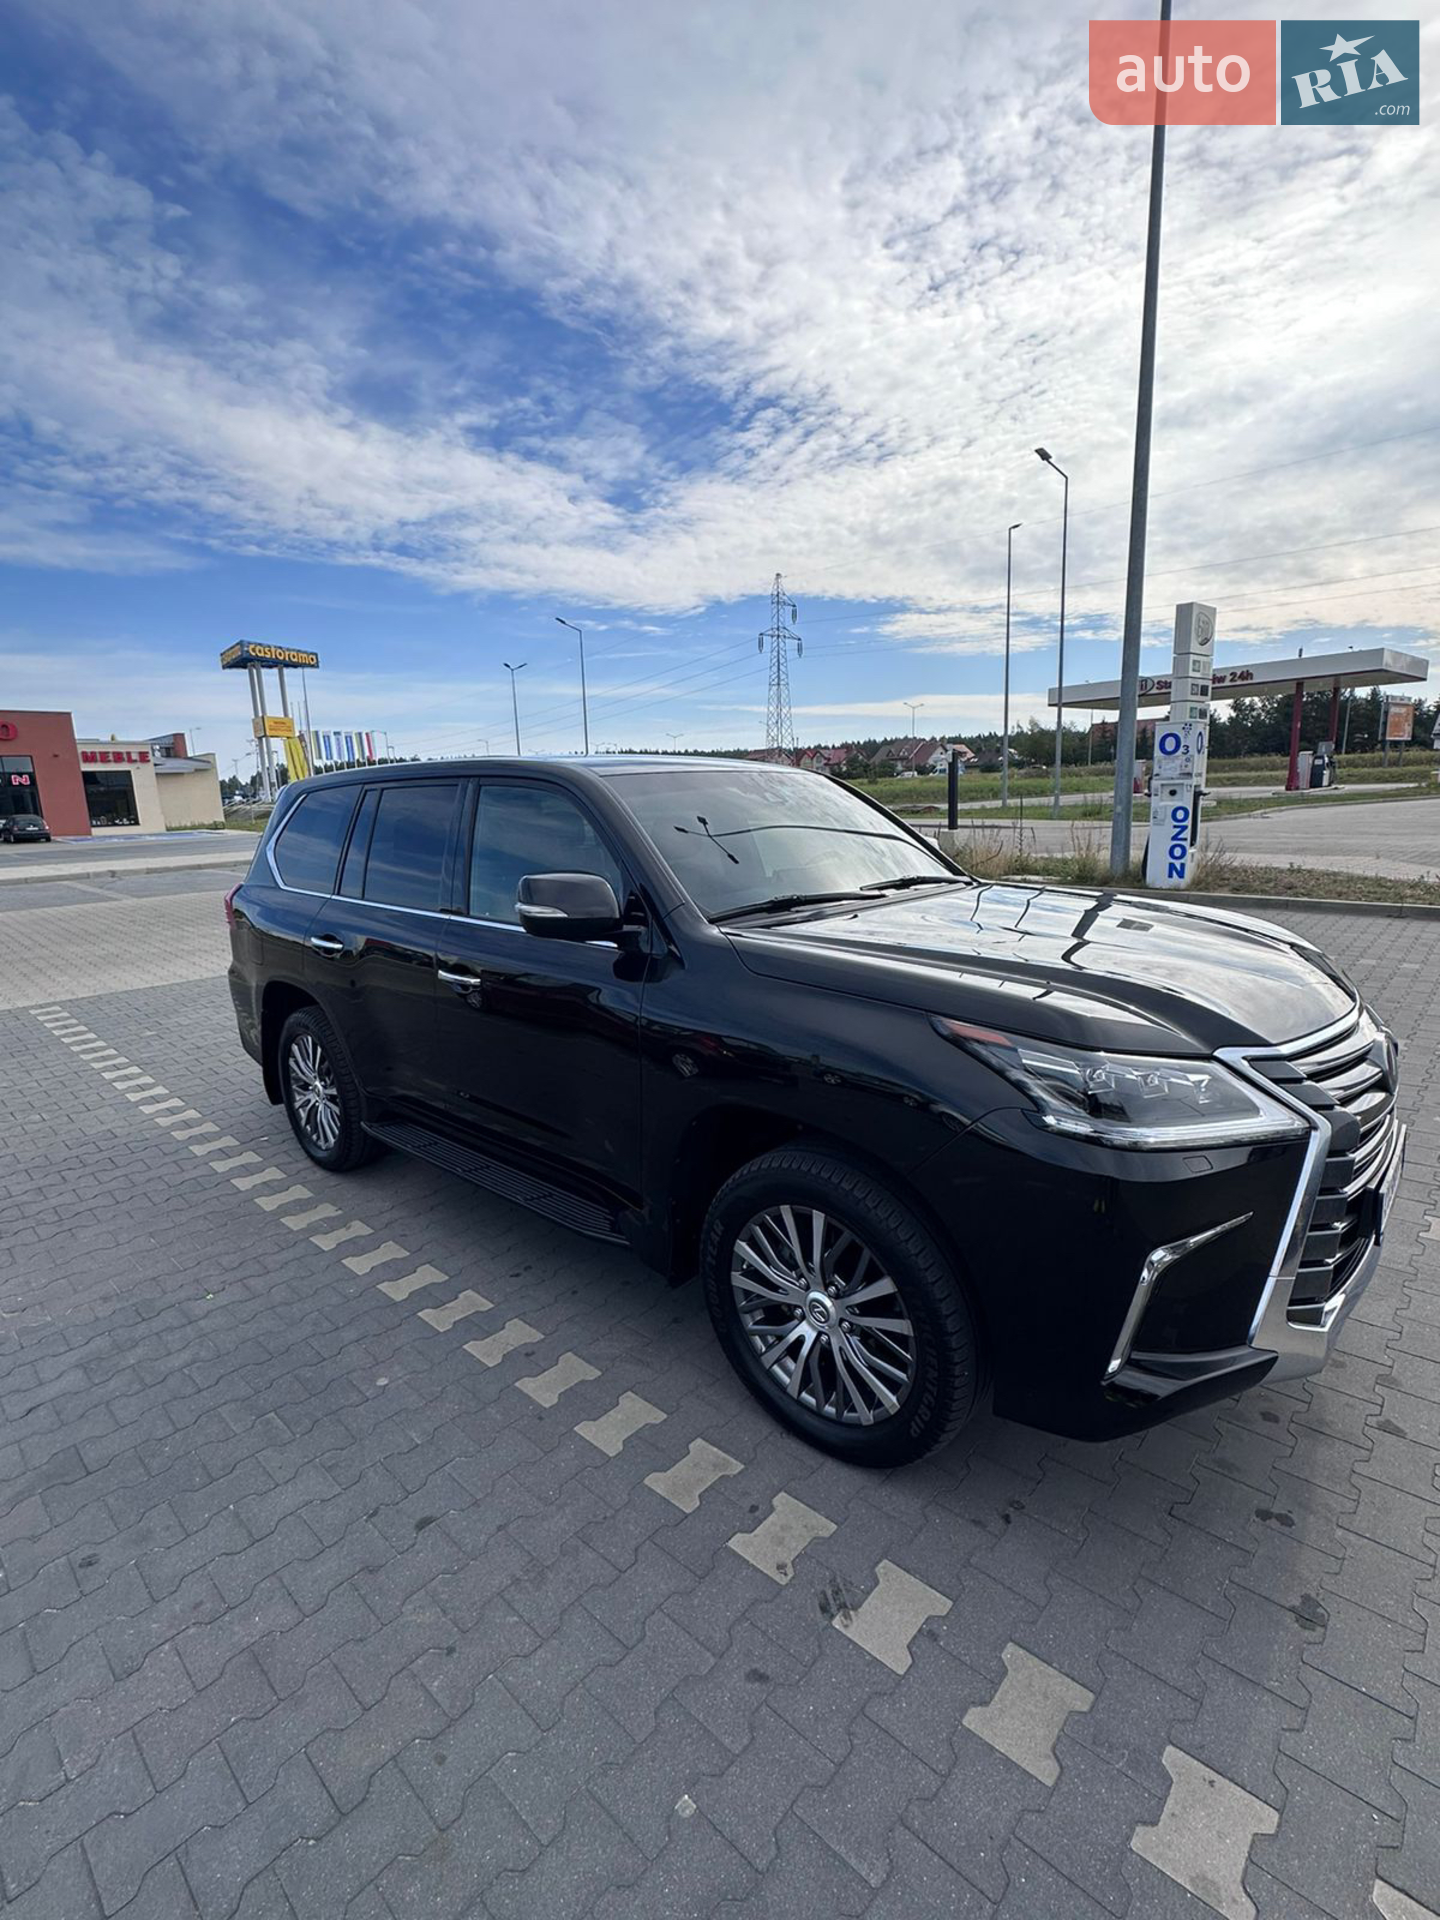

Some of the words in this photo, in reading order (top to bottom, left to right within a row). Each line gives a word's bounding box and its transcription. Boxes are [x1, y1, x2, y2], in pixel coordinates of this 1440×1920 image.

[1229, 669, 1254, 682] 24h
[80, 750, 151, 763] MEBLE
[1167, 806, 1190, 879] OZON
